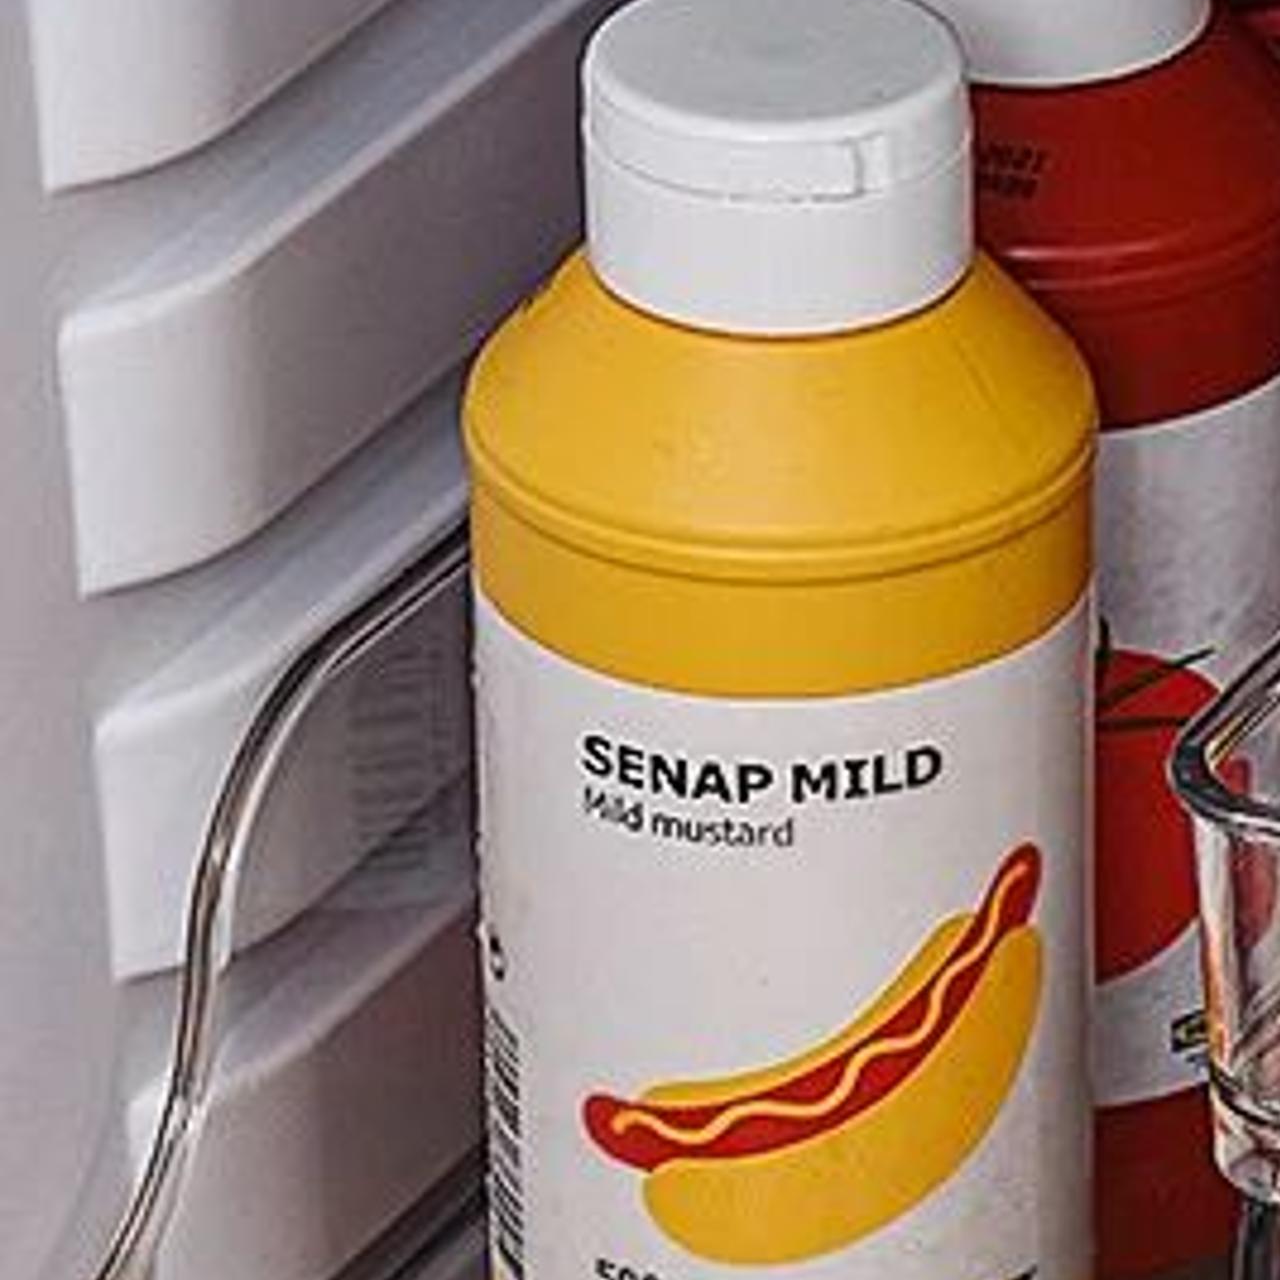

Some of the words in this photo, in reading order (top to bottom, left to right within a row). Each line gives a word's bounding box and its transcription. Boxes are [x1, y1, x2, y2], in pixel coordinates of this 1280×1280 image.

[583, 734, 774, 805] SENAP
[789, 745, 944, 803] MILD
[650, 813, 796, 849] mustard
